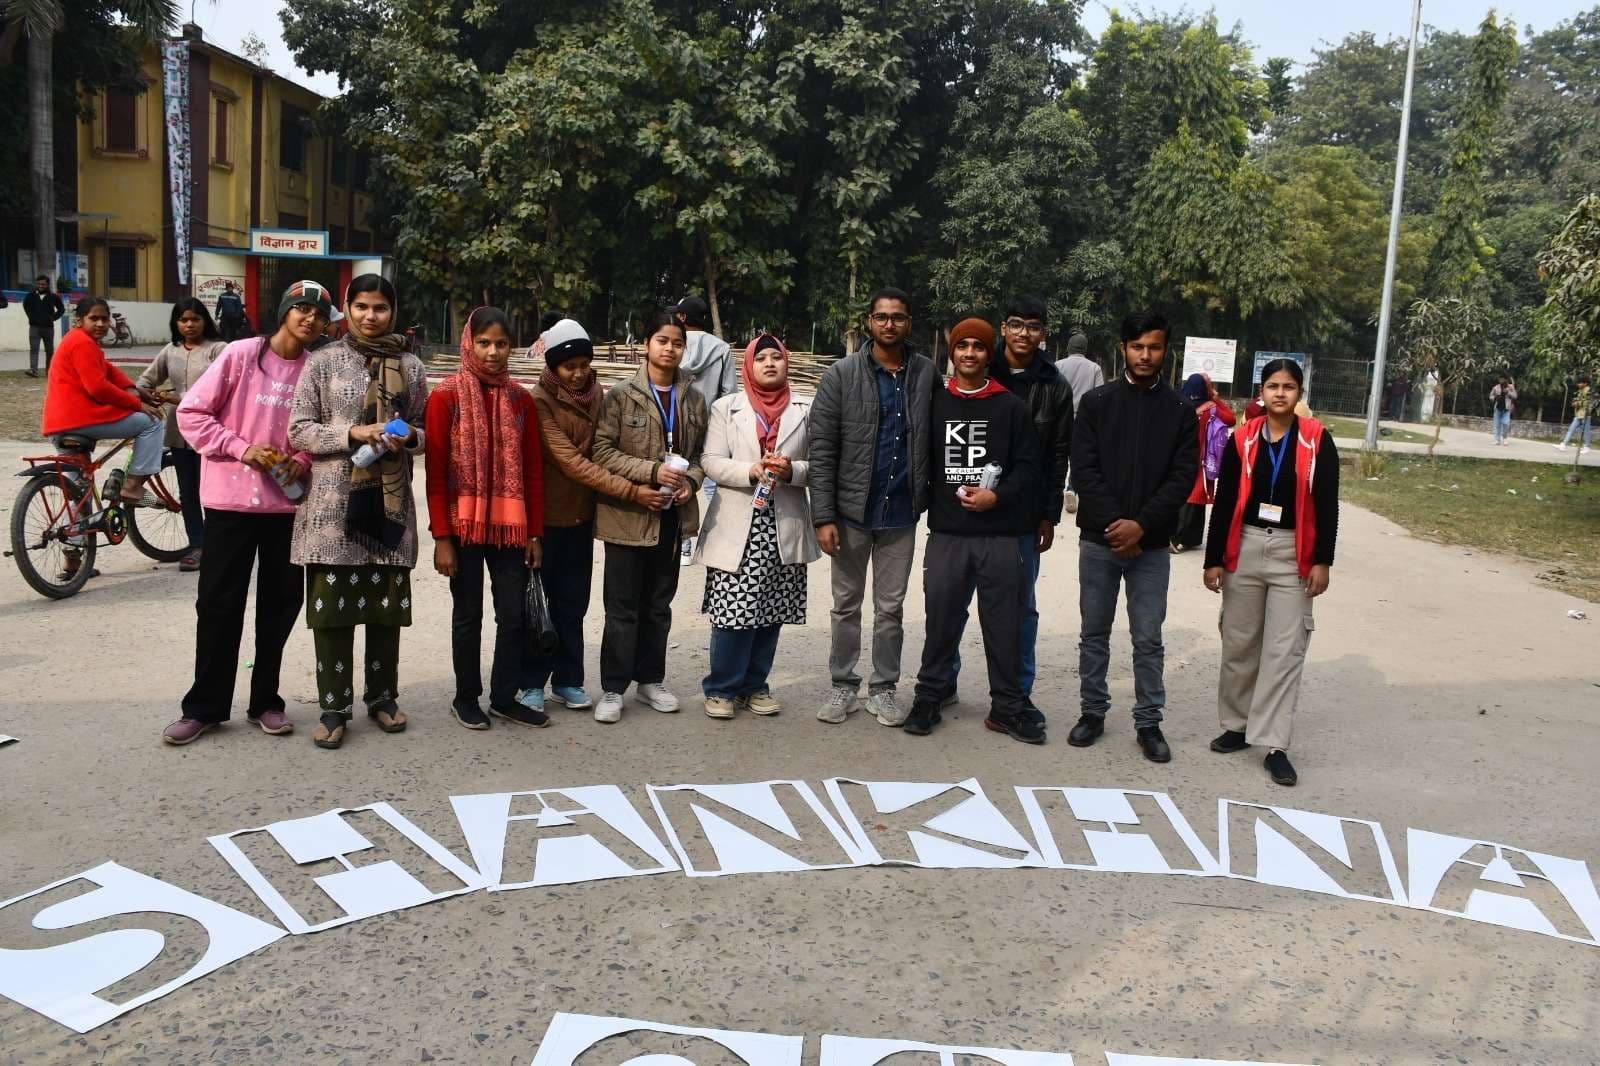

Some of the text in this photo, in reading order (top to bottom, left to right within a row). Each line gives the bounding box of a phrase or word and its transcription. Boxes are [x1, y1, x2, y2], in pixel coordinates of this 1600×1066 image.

[260, 236, 318, 250] विज्ञान द्वार
[945, 423, 987, 444] KE
[944, 446, 987, 467] EP
[965, 474, 984, 482] PRA
